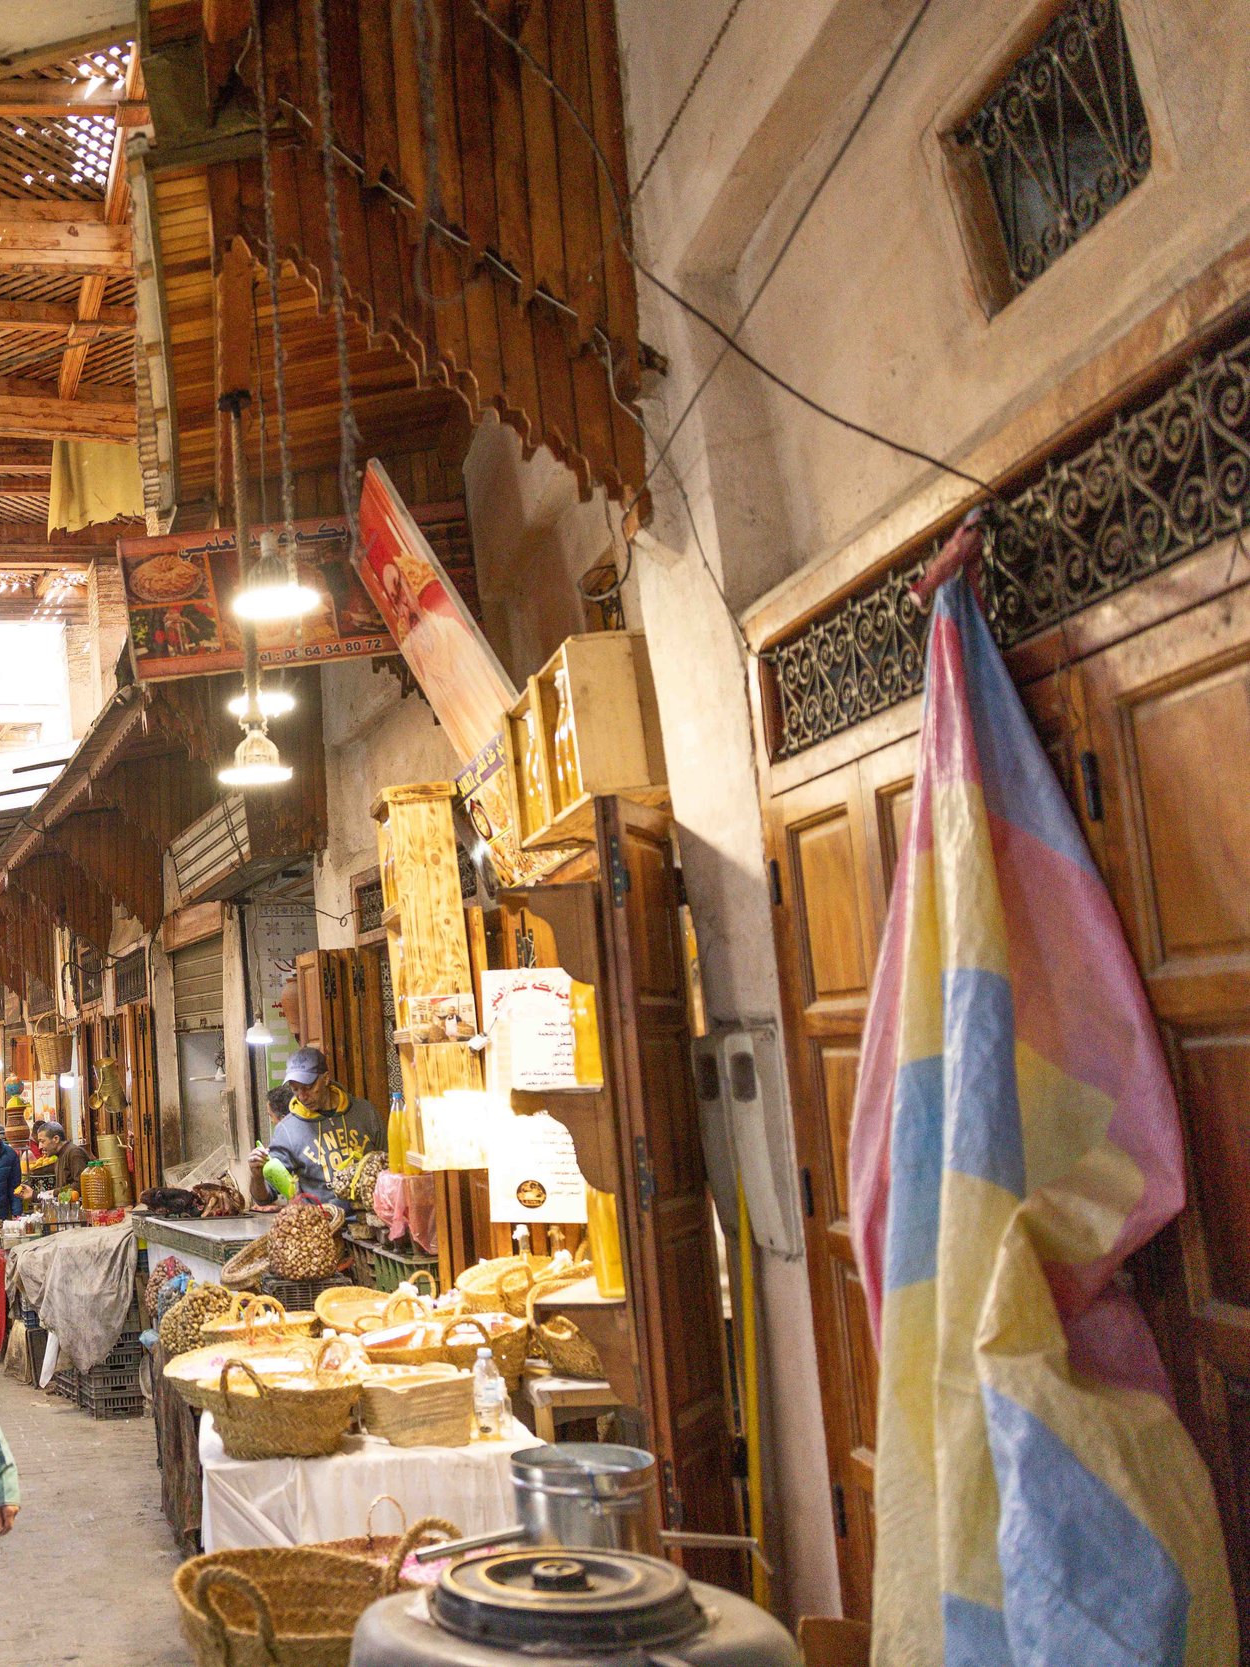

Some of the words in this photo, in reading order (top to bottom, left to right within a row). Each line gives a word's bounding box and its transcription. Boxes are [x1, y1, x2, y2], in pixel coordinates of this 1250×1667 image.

[294, 522, 348, 544] بكم
[304, 645, 321, 657] 64
[325, 643, 342, 655] 34
[345, 641, 361, 653] 80
[365, 638, 382, 650] 72
